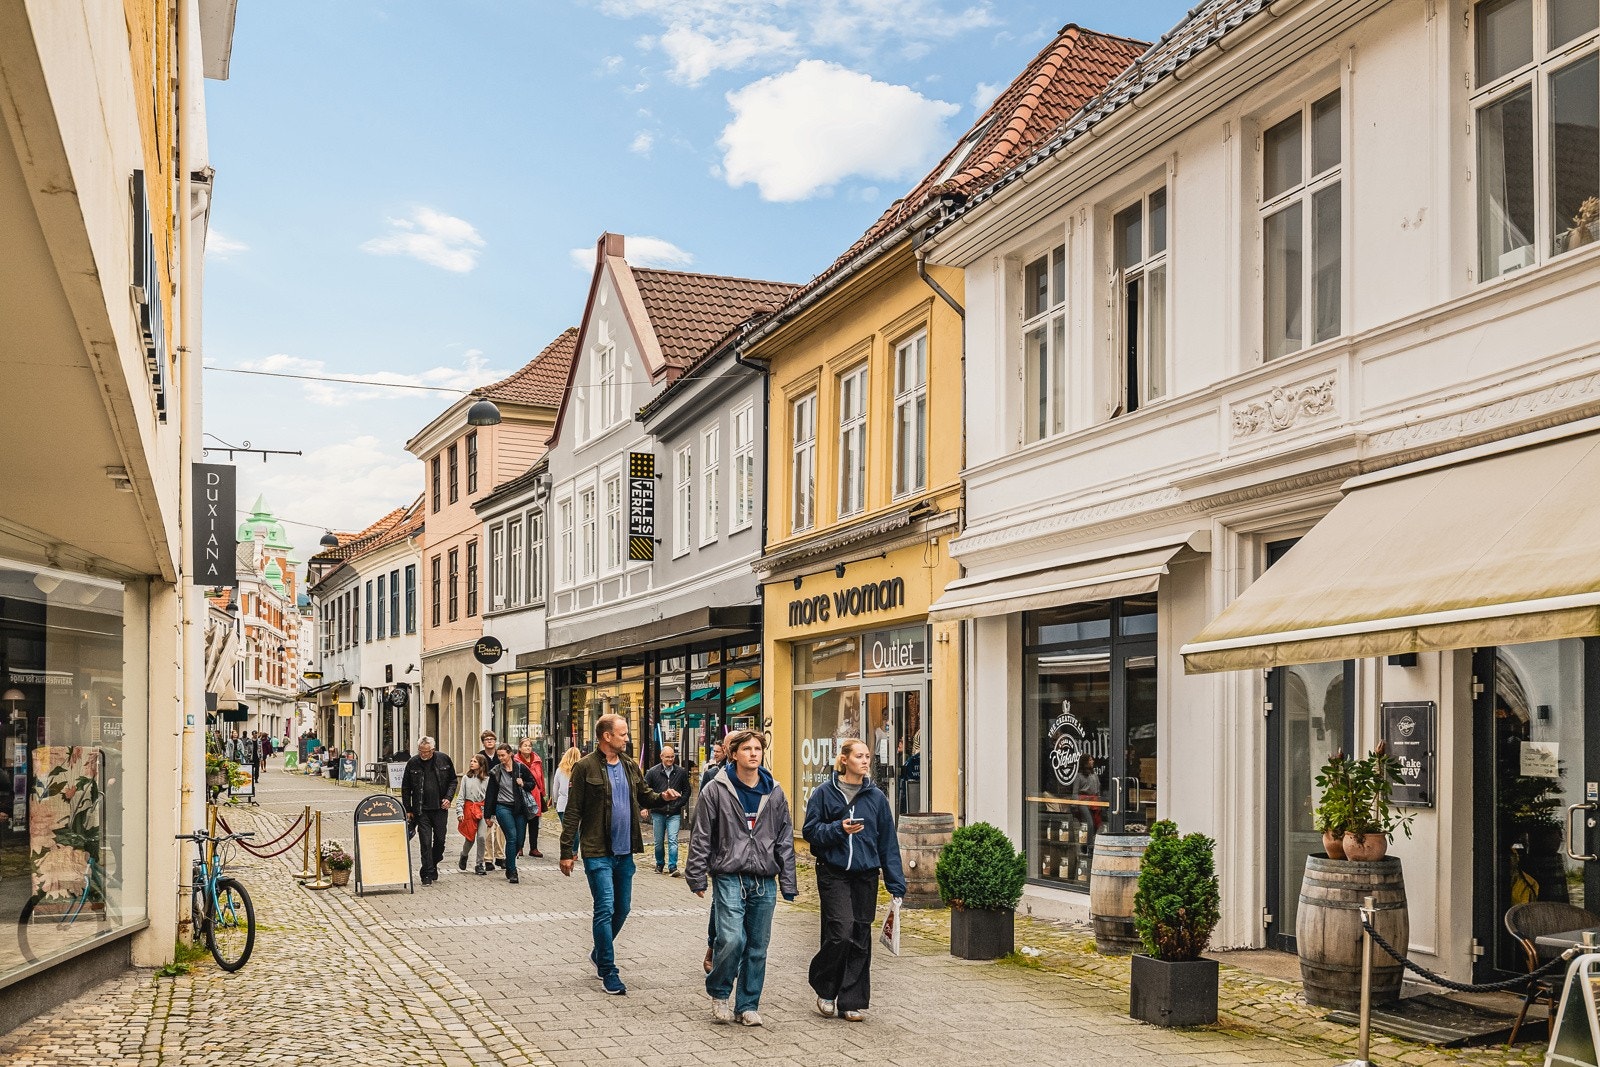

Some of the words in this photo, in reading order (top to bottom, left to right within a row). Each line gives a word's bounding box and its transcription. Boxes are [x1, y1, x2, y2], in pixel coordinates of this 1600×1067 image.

[631, 480, 642, 534] VERKET
[642, 480, 653, 534] FELLES
[206, 472, 220, 576] DUXIANA
[789, 594, 830, 628] more
[833, 576, 904, 619] woman
[477, 643, 501, 656] Beauty
[872, 638, 914, 670] Outlet
[1048, 723, 1057, 738] THE
[1055, 715, 1079, 727] CREATIVE
[1077, 722, 1086, 738] LAB
[801, 738, 845, 766] OUTLE
[1050, 748, 1083, 770] Stefano
[1398, 755, 1421, 768] Take
[802, 771, 813, 782] Alle
[814, 773, 830, 783] varer
[1396, 766, 1421, 779] way
